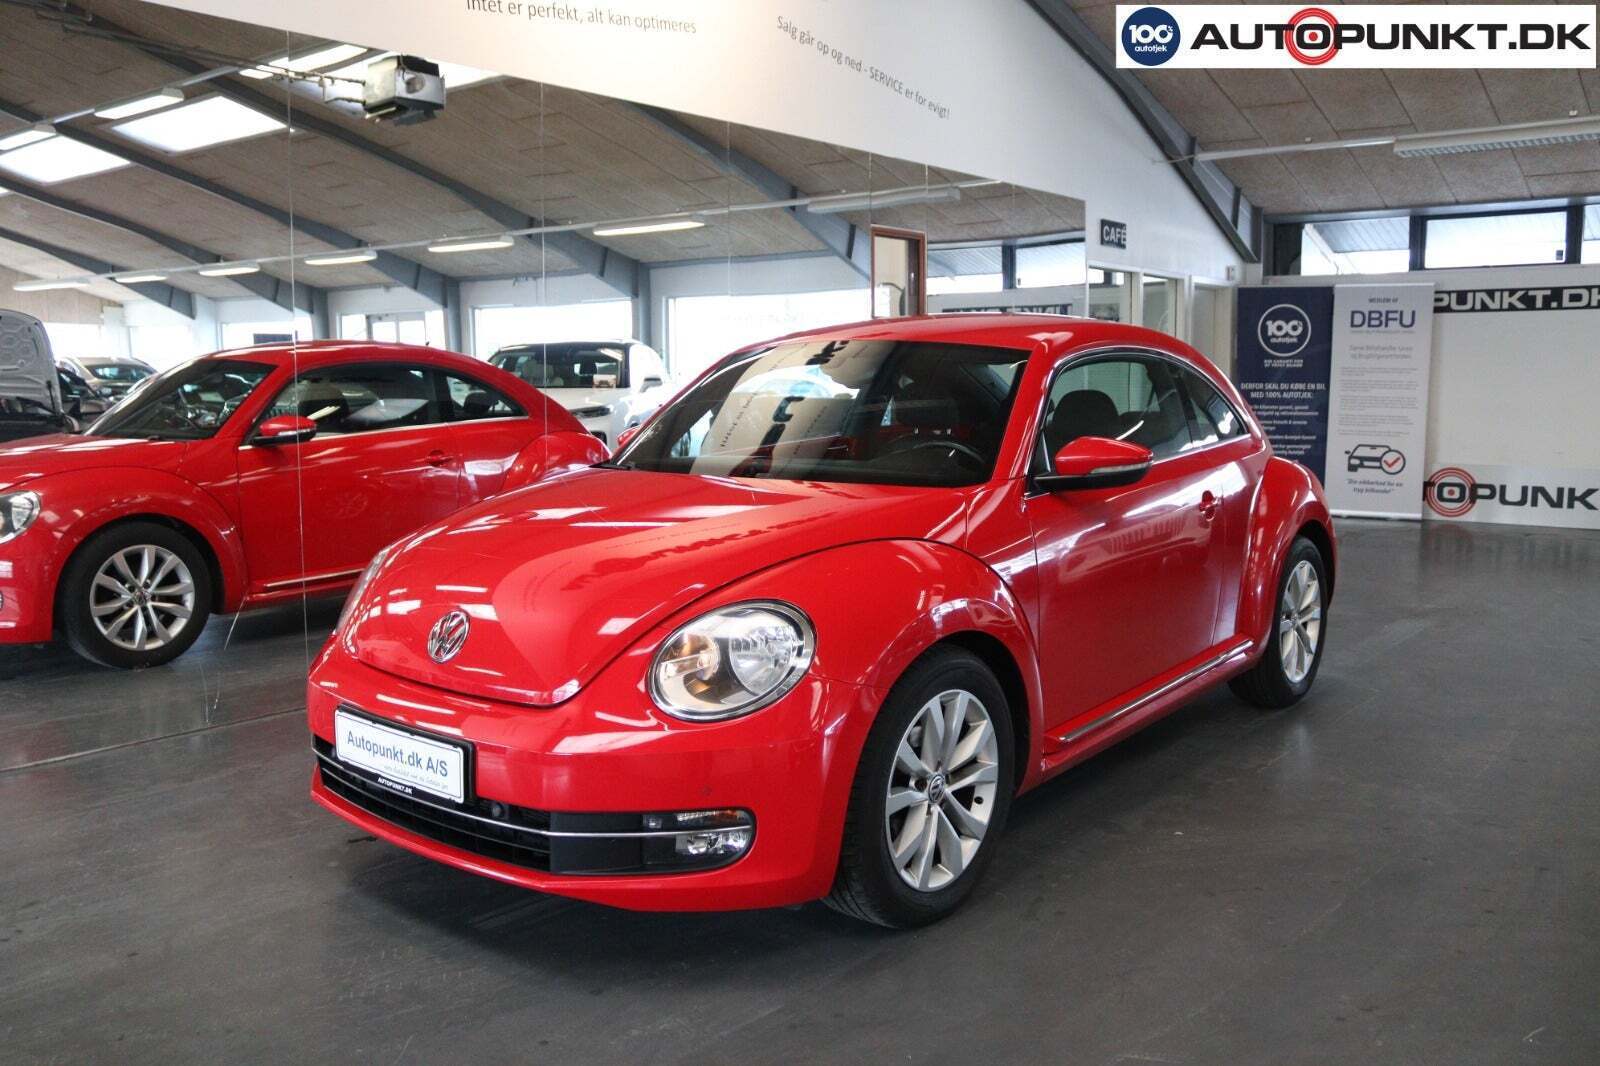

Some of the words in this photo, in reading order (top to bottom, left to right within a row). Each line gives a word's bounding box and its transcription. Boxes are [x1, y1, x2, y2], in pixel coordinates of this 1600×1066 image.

[508, 3, 522, 16] er
[528, 4, 583, 24] perfekt,
[587, 9, 603, 24] alt
[608, 10, 631, 27] kan
[635, 15, 697, 34] optimeres
[777, 15, 797, 40] Salg
[799, 30, 815, 45] går
[817, 40, 829, 55] op
[831, 49, 843, 65] og
[845, 55, 862, 73] ned
[869, 66, 903, 95] SERVICE
[905, 86, 914, 99] er
[915, 90, 927, 106] for
[1350, 310, 1416, 328] DBFU
[347, 730, 423, 769] Autopunkt.dk
[426, 756, 448, 777] A/S
[377, 776, 413, 795] AUTOPUNKT.DK
